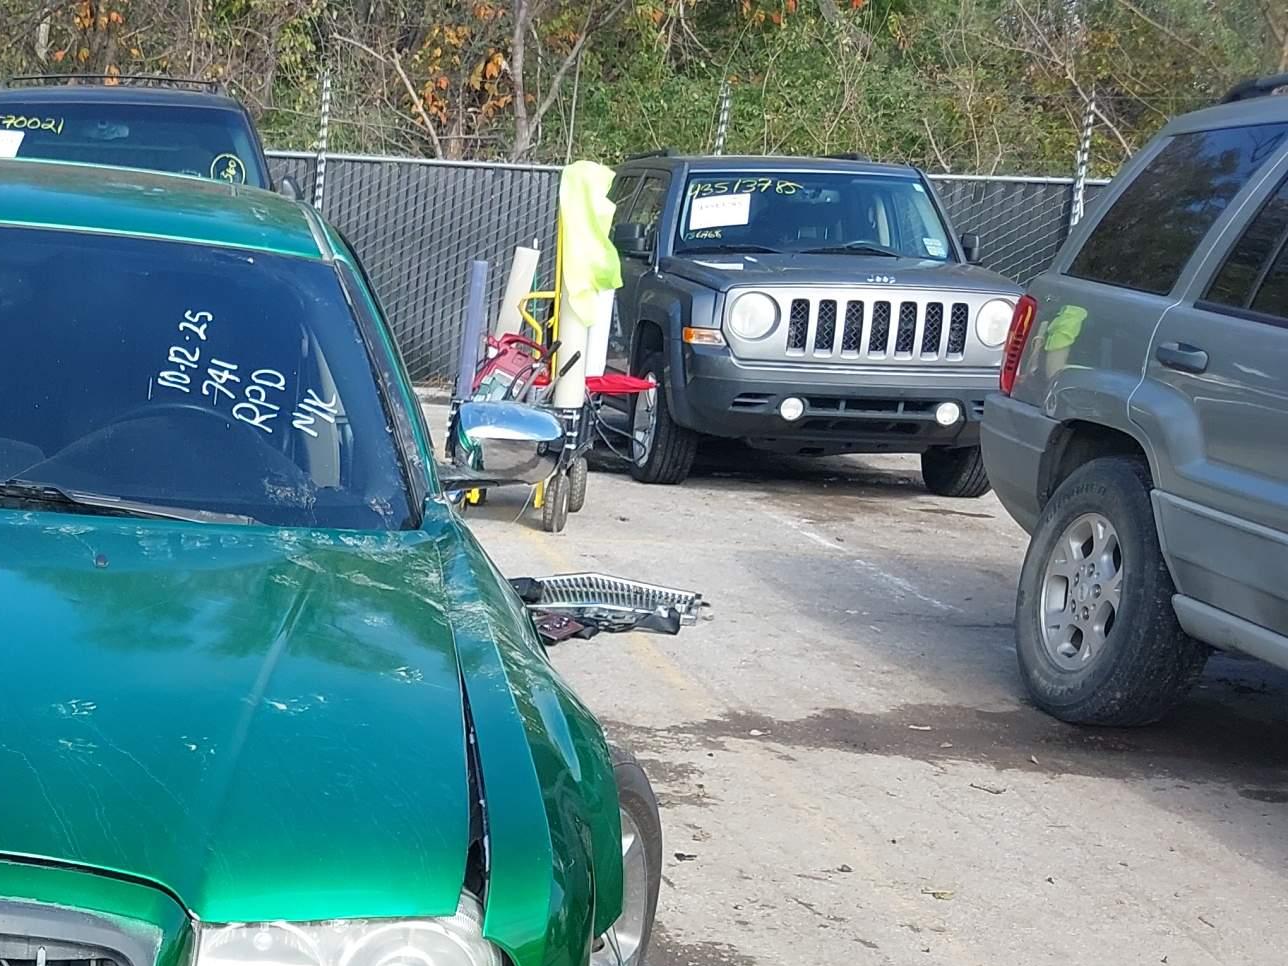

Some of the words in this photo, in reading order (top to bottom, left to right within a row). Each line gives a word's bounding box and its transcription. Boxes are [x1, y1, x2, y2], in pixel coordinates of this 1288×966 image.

[689, 178, 803, 199] 43513785
[202, 358, 241, 399] 741
[232, 369, 286, 433] RPD
